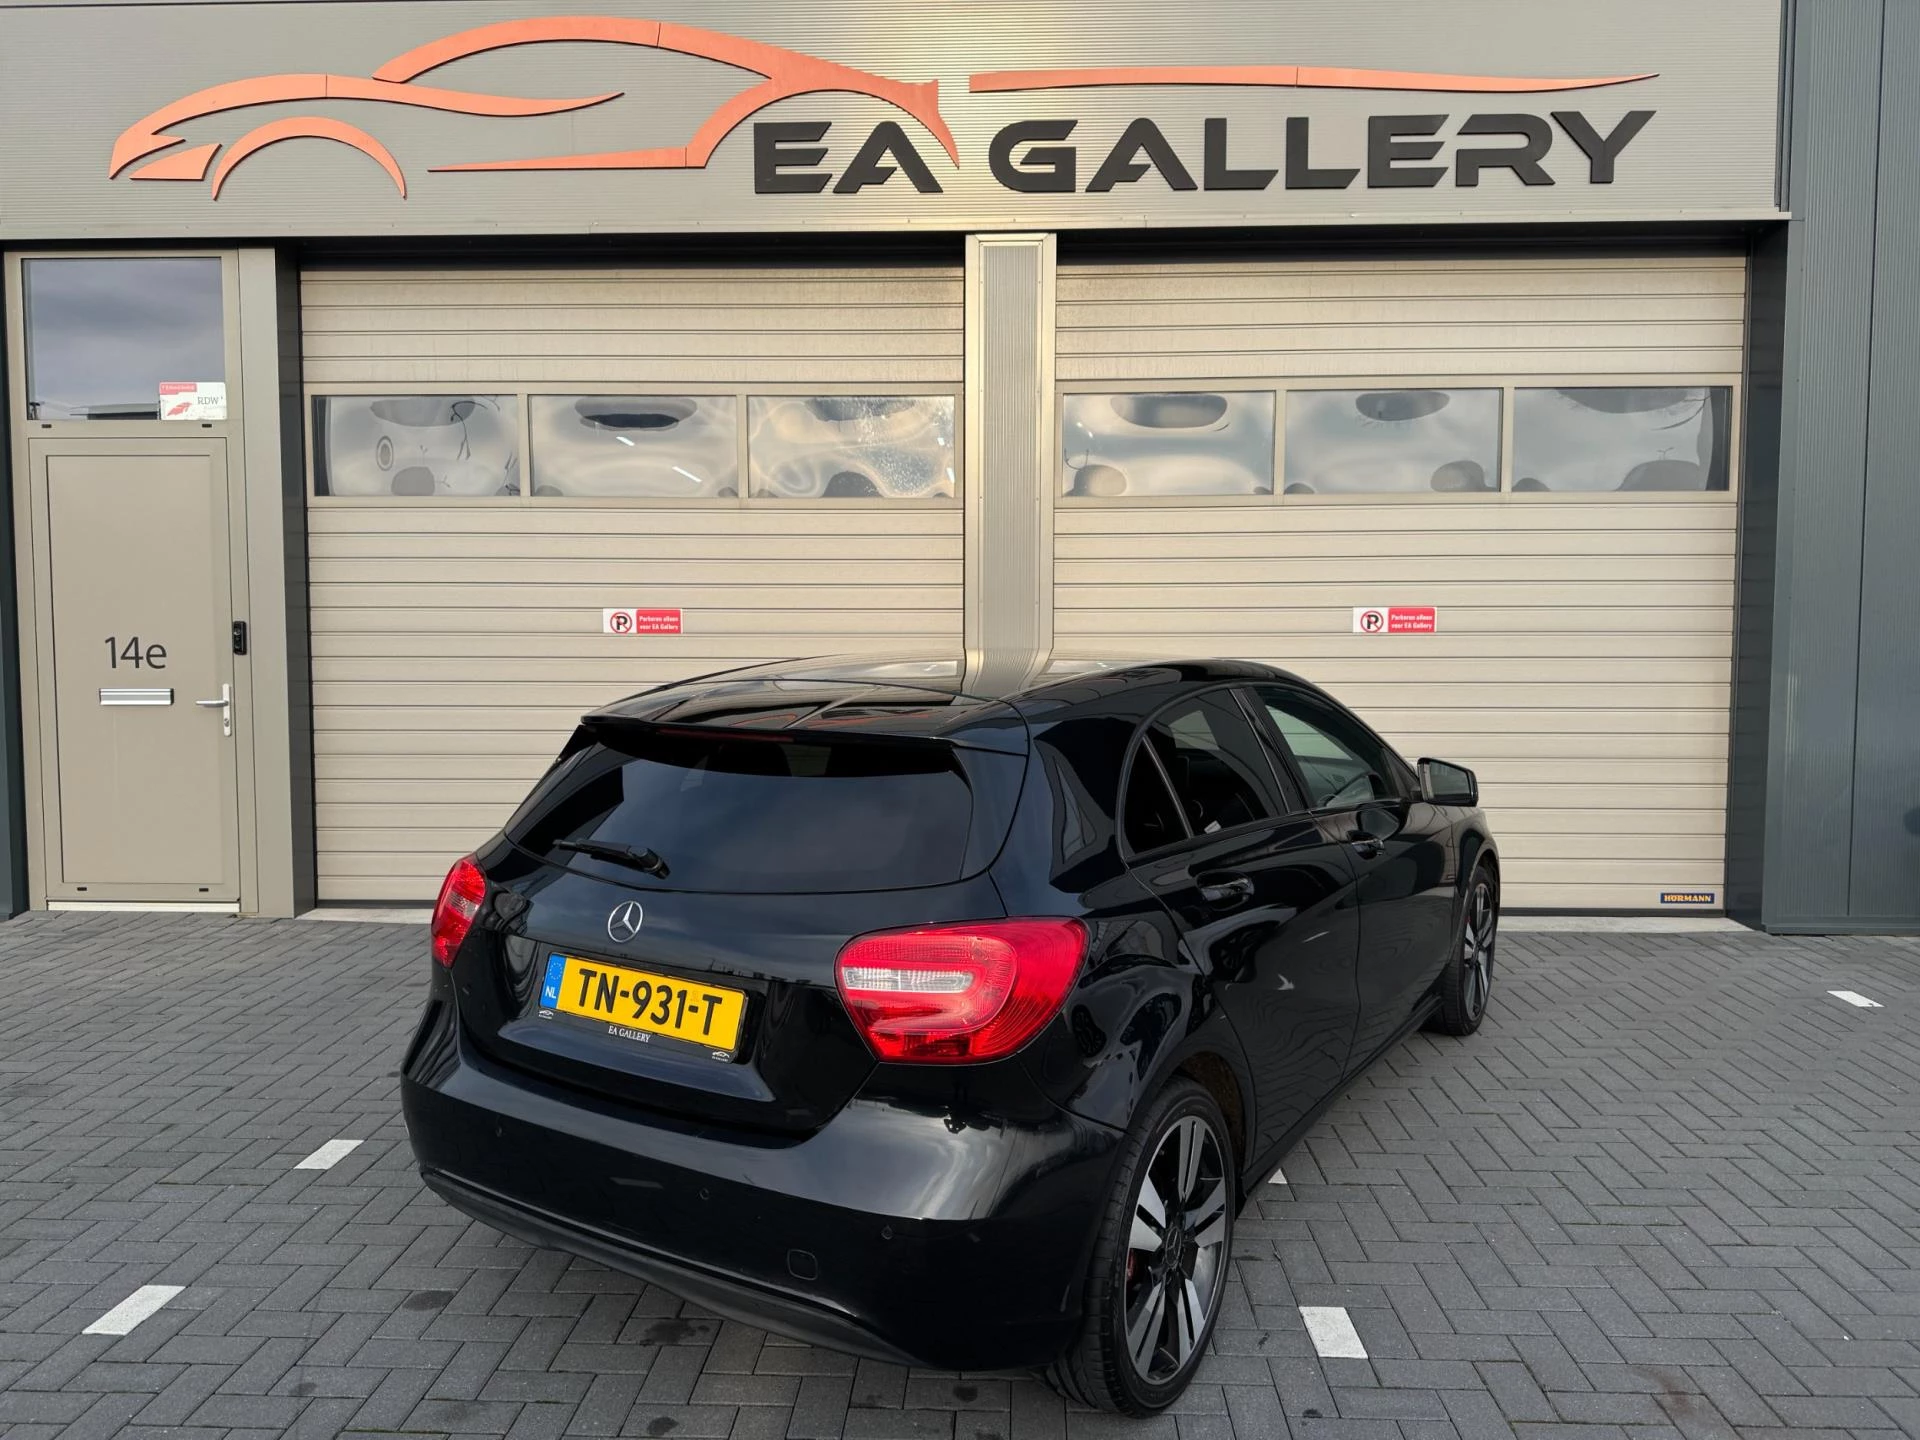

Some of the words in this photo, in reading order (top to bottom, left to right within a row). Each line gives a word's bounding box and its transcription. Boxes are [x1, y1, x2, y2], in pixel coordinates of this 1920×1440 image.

[754, 121, 943, 194] EA
[988, 110, 1657, 193] GALLERY
[105, 636, 167, 669] 14e
[545, 985, 557, 999] NL
[579, 968, 723, 1035] TN-931-T
[608, 1025, 619, 1036] EA
[619, 1028, 651, 1044] GALLERY
